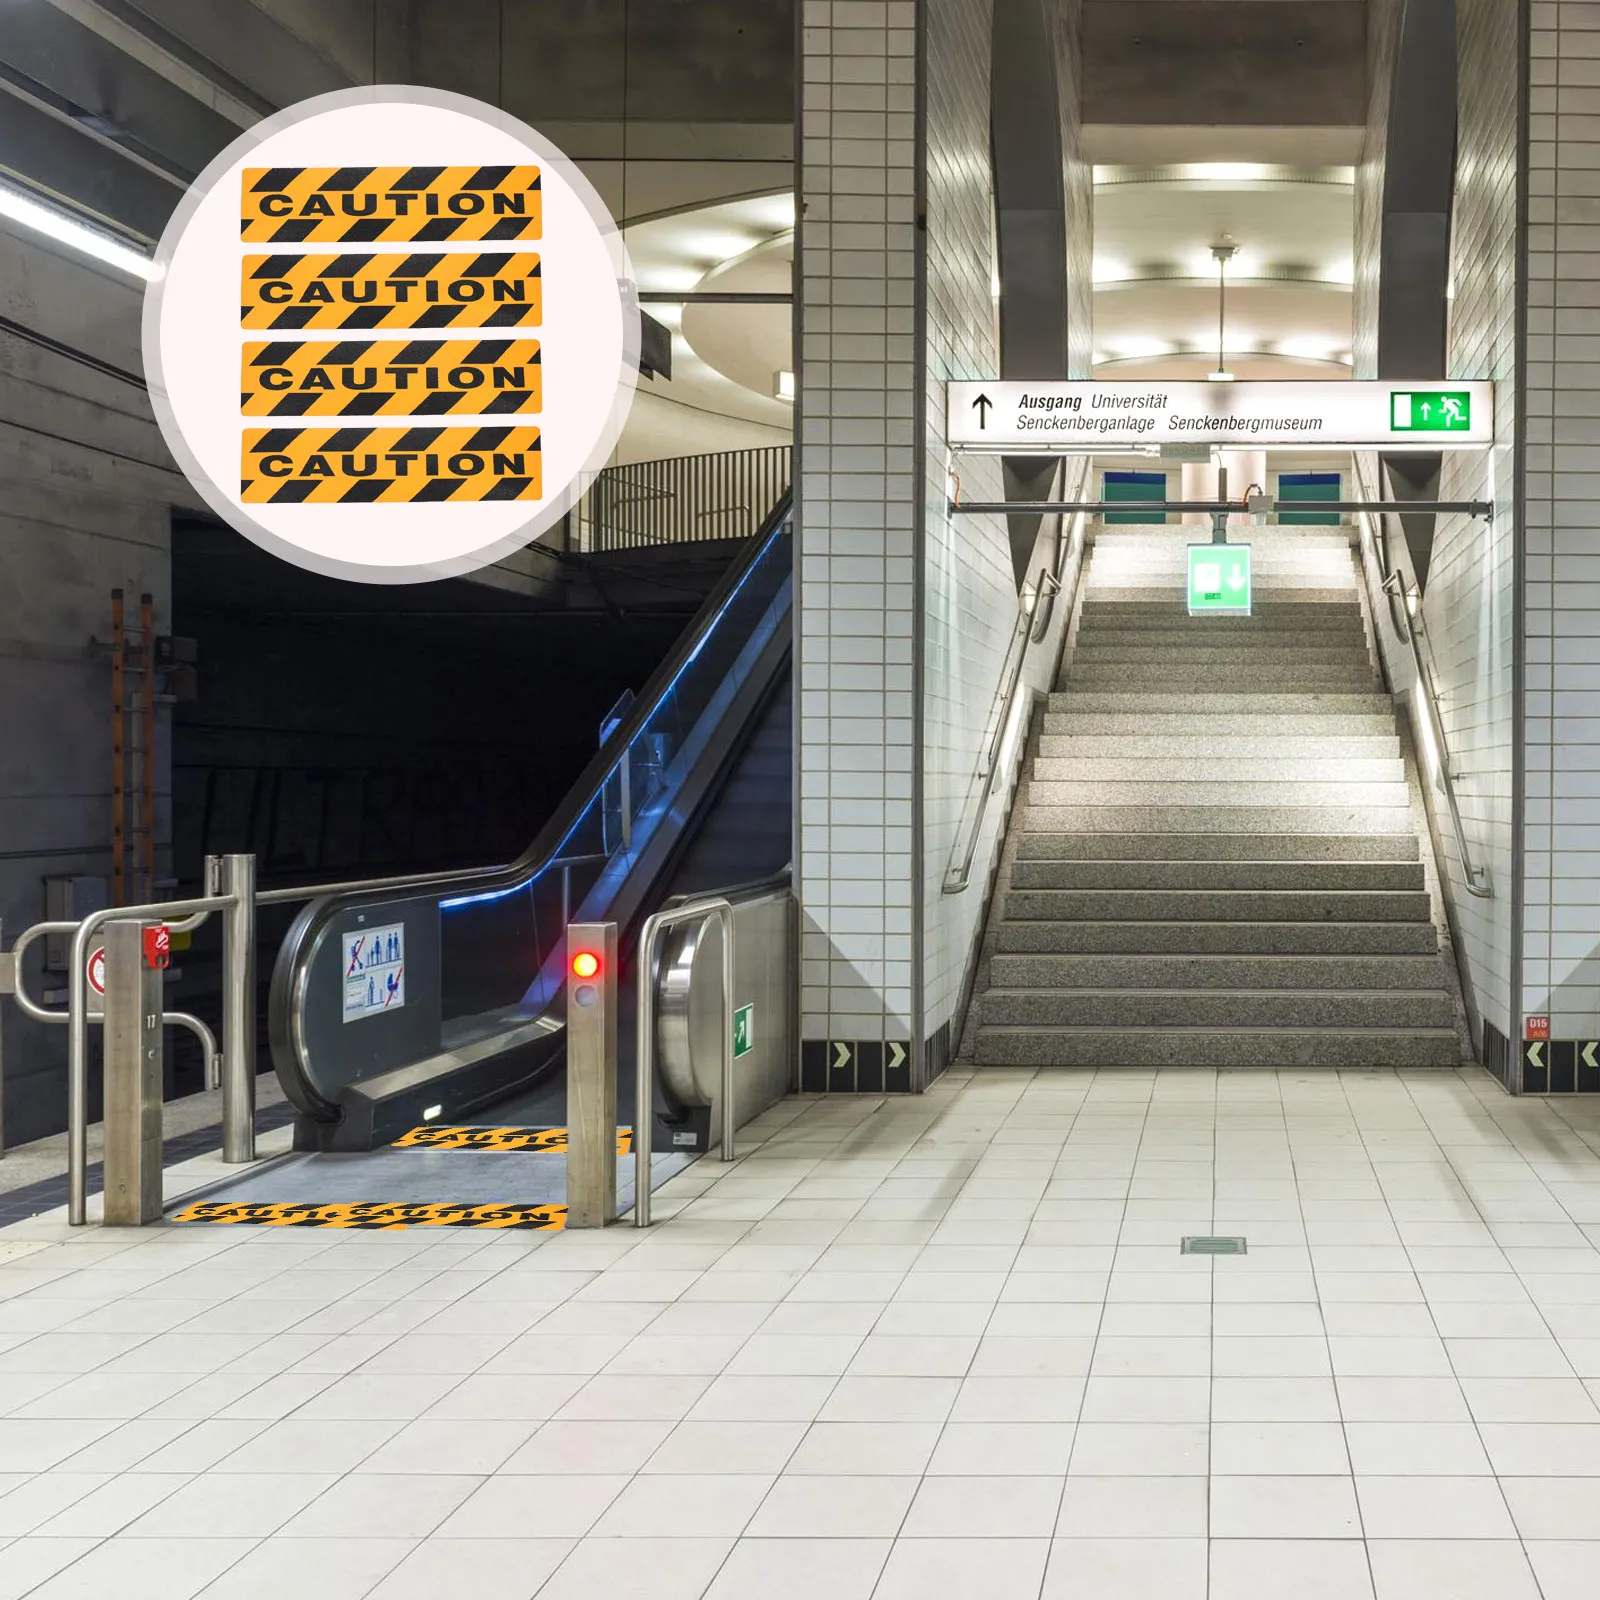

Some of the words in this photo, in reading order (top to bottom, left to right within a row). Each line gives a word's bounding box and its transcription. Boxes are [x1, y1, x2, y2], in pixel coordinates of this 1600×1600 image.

[1018, 393, 1082, 412] Ausgang
[1091, 393, 1168, 409] Universität
[1016, 414, 1155, 433] Senckenberganlage
[1168, 414, 1323, 433] Senckenbergmuseum
[414, 1133, 568, 1144] CAUTIO
[350, 1208, 549, 1221] CAUTION
